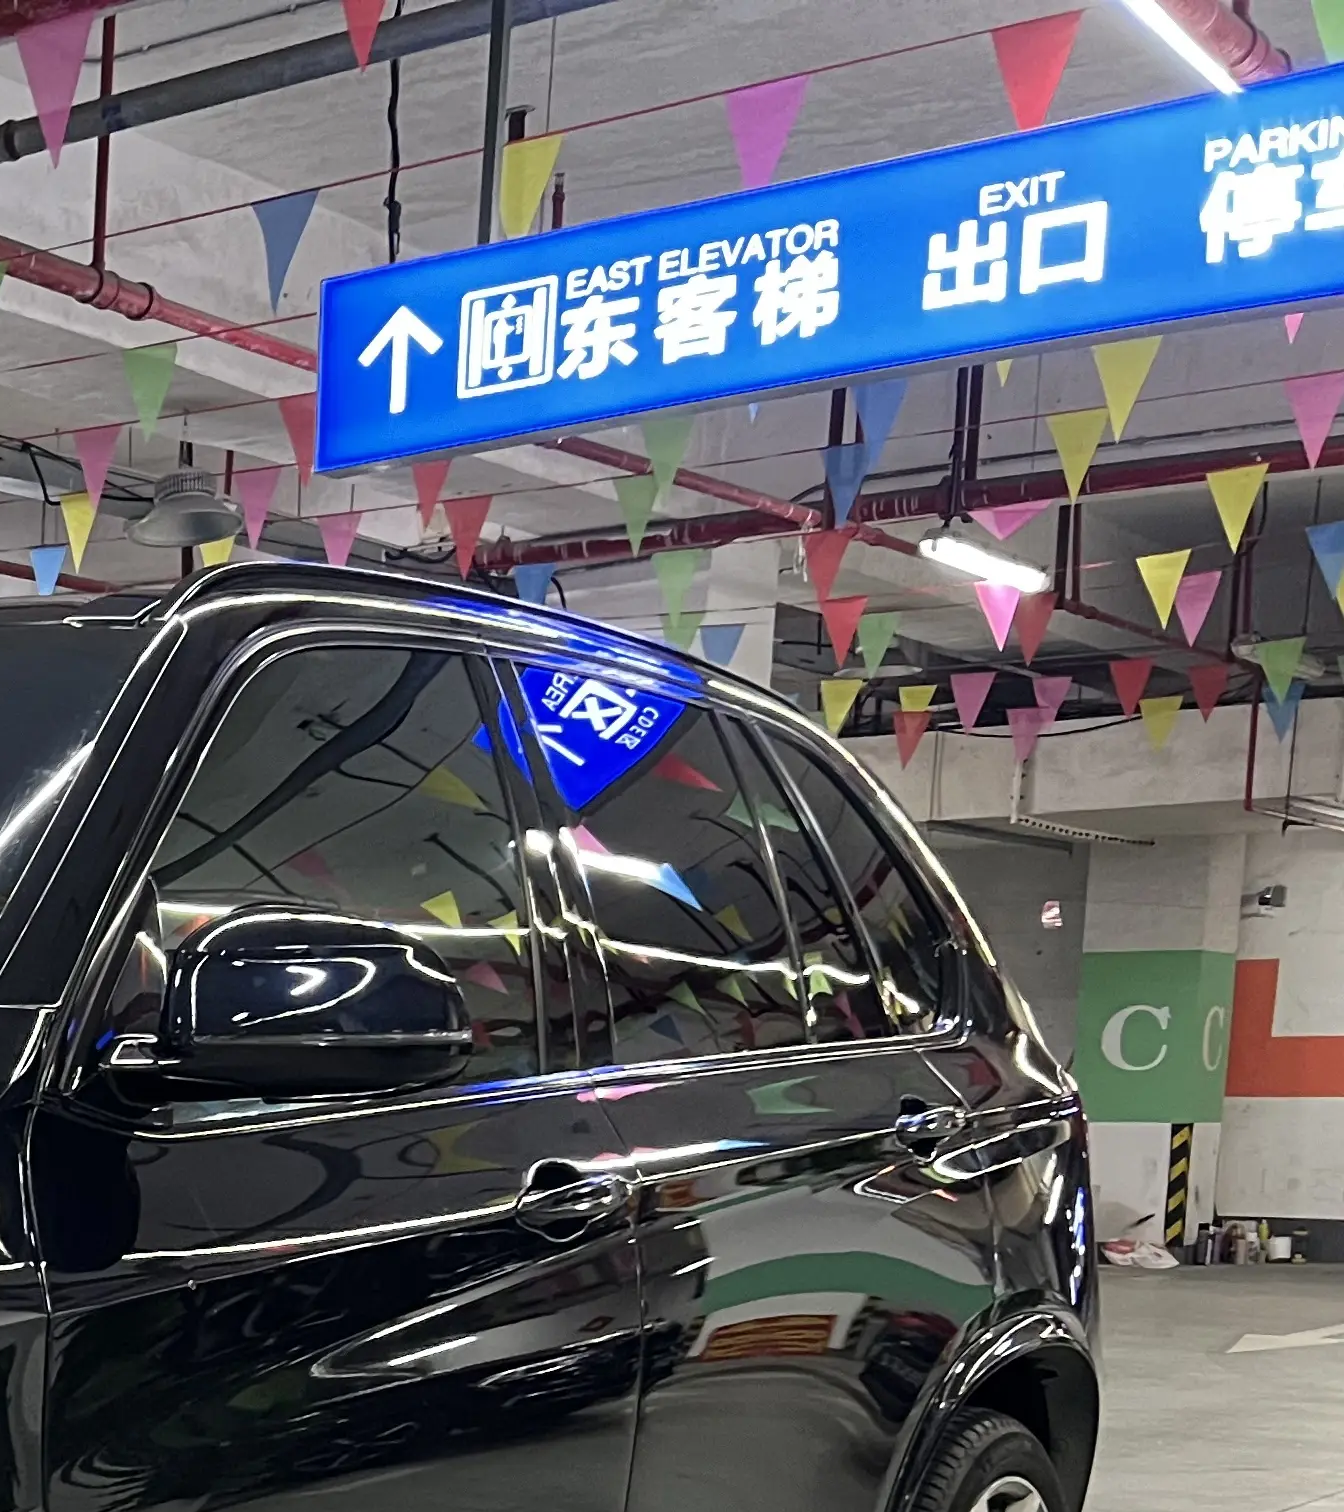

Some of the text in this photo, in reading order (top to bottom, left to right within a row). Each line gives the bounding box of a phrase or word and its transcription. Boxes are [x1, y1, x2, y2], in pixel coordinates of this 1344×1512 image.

[978, 170, 1066, 217] EXIT
[565, 218, 840, 300] EAST ELEVATOR
[921, 200, 1109, 311] 出口
[556, 249, 840, 380] 东客梯
[1100, 1004, 1172, 1071] C
[1201, 1004, 1225, 1071] C
